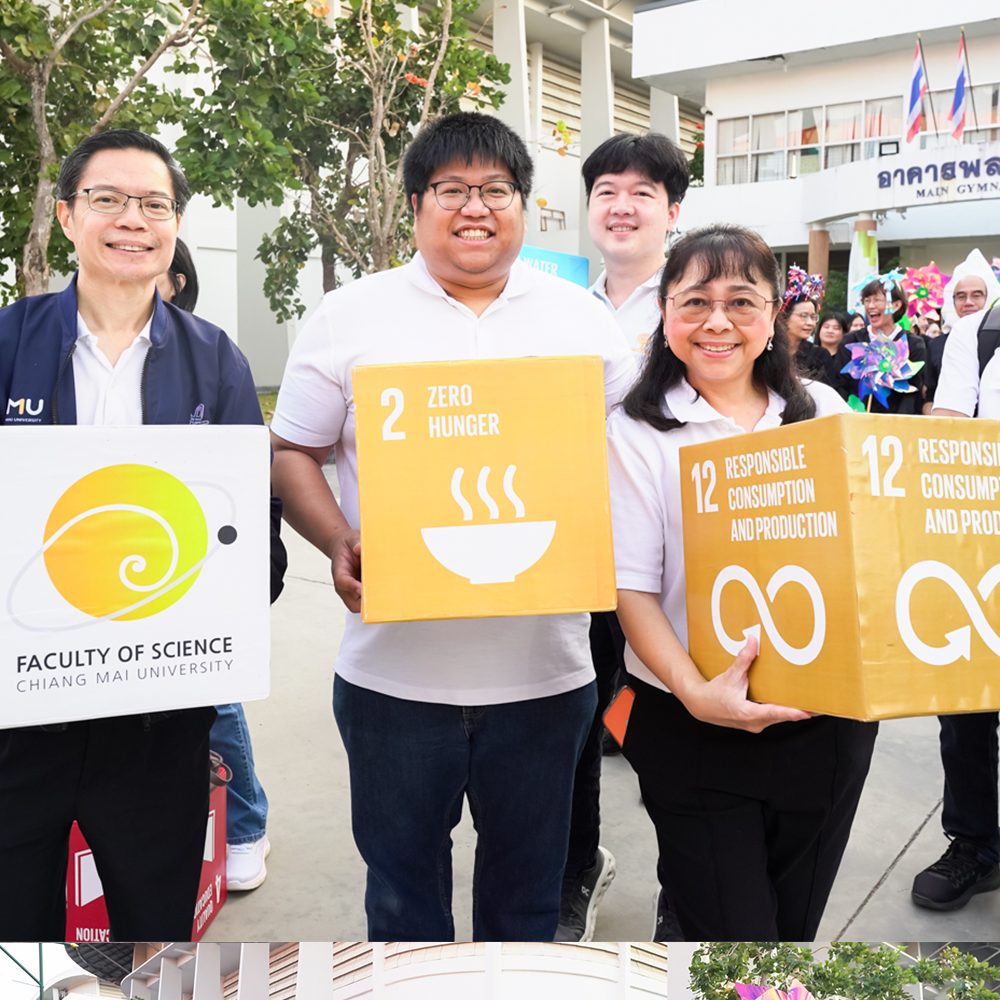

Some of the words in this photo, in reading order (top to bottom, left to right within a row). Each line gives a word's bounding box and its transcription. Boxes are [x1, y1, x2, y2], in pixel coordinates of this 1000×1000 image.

[916, 186, 949, 199] MAIN
[380, 387, 407, 441] 2
[427, 384, 473, 408] ZERO
[428, 413, 501, 438] HUNGER
[691, 459, 719, 514] 12
[724, 443, 808, 480] RESPONSIBLE
[861, 434, 906, 498] 12
[727, 477, 816, 511] CONSUMPTION
[920, 472, 1000, 501] CONSUMP
[730, 517, 755, 542] AND
[755, 510, 838, 541] PRODUCTION
[925, 508, 959, 534] AND
[16, 647, 111, 674] FACULTY
[117, 645, 145, 662] OF
[151, 636, 233, 661] SCIENCE
[16, 673, 87, 693] CHIANG
[96, 669, 129, 685] MAI
[137, 659, 235, 681] UNIVERSITY
